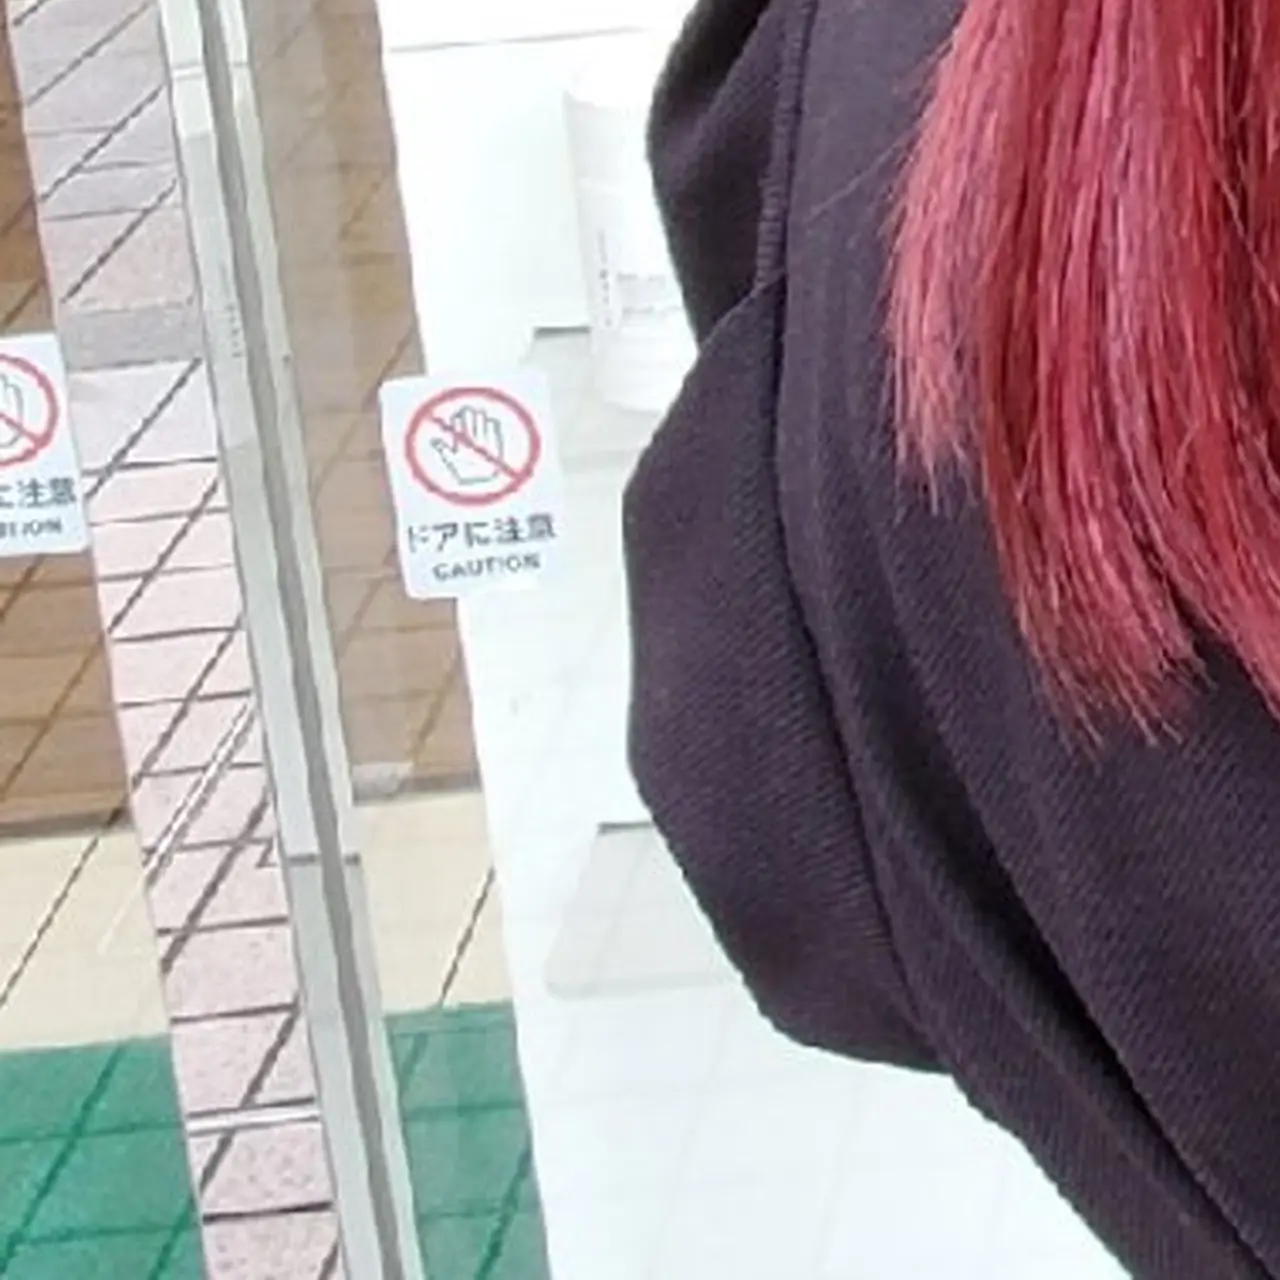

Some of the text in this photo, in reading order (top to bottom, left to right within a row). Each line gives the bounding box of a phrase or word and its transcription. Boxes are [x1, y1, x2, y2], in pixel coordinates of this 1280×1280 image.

[408, 513, 556, 553] ドアに注意
[432, 553, 541, 582] CAUTION
